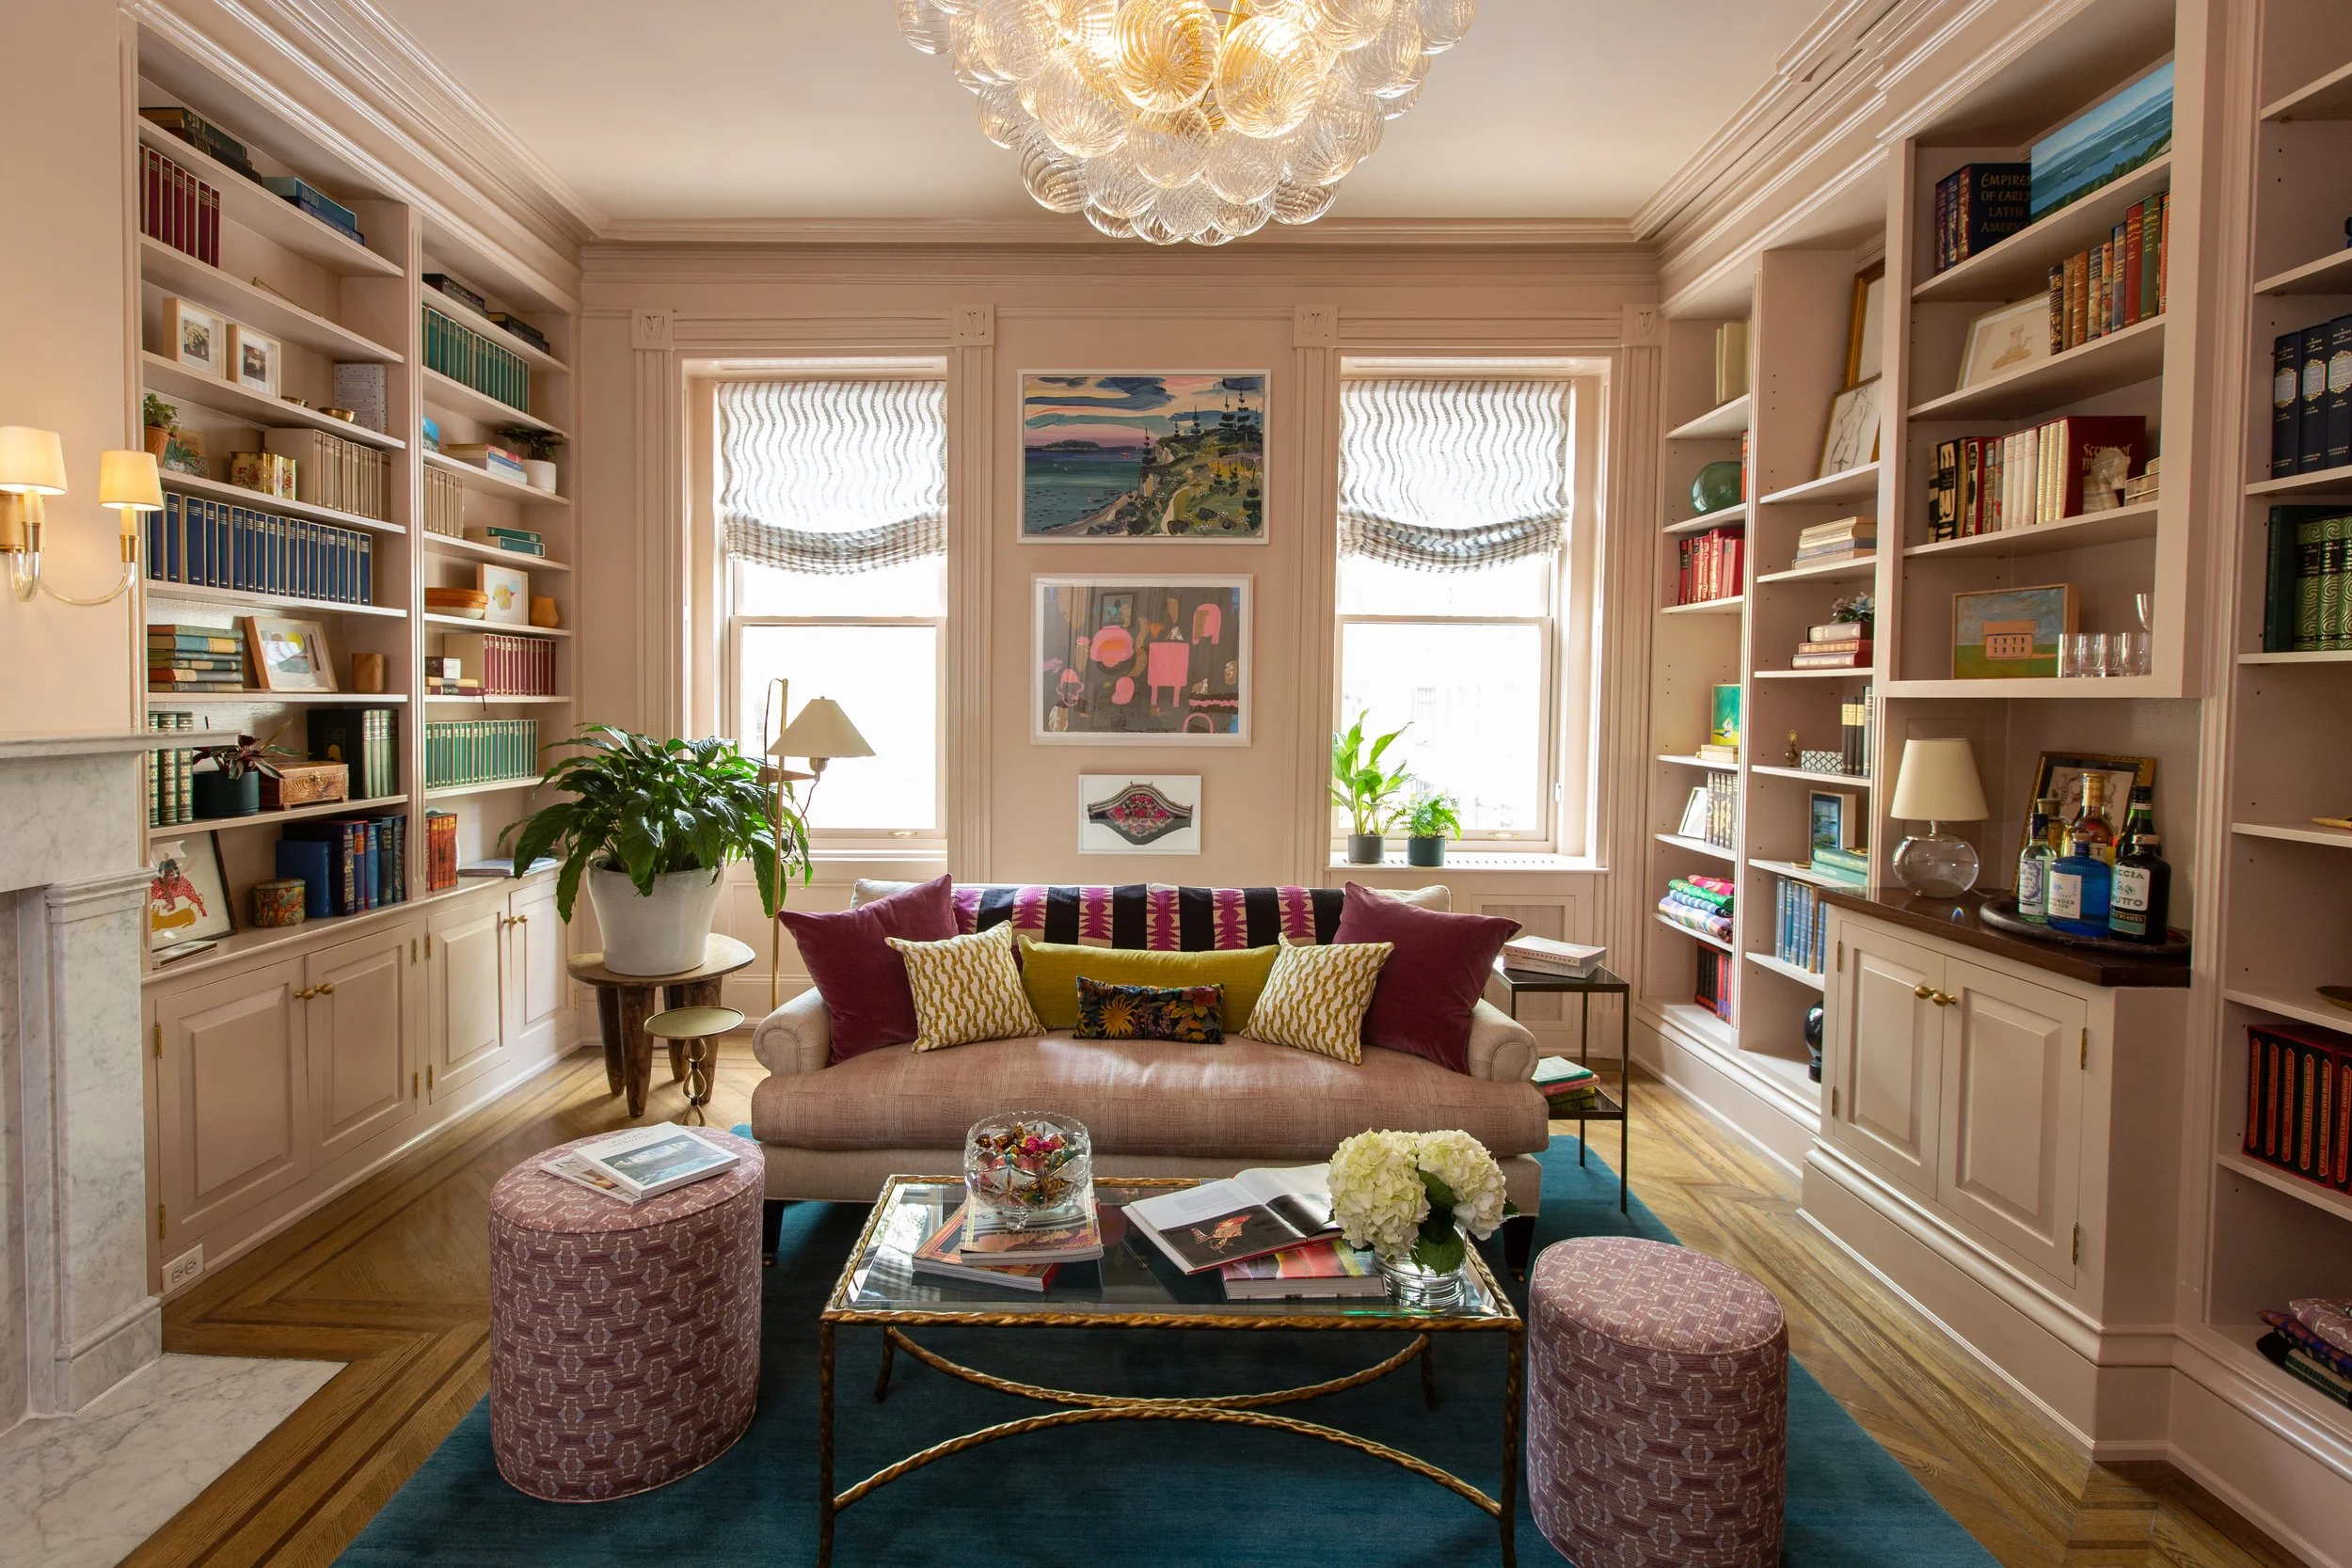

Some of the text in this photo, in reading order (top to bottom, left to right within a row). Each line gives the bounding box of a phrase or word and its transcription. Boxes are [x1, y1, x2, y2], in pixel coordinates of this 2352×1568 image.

[1980, 173, 2031, 187] EMPIRES
[1980, 191, 2031, 201] OF EARLY
[1988, 207, 2025, 217] LATIN
